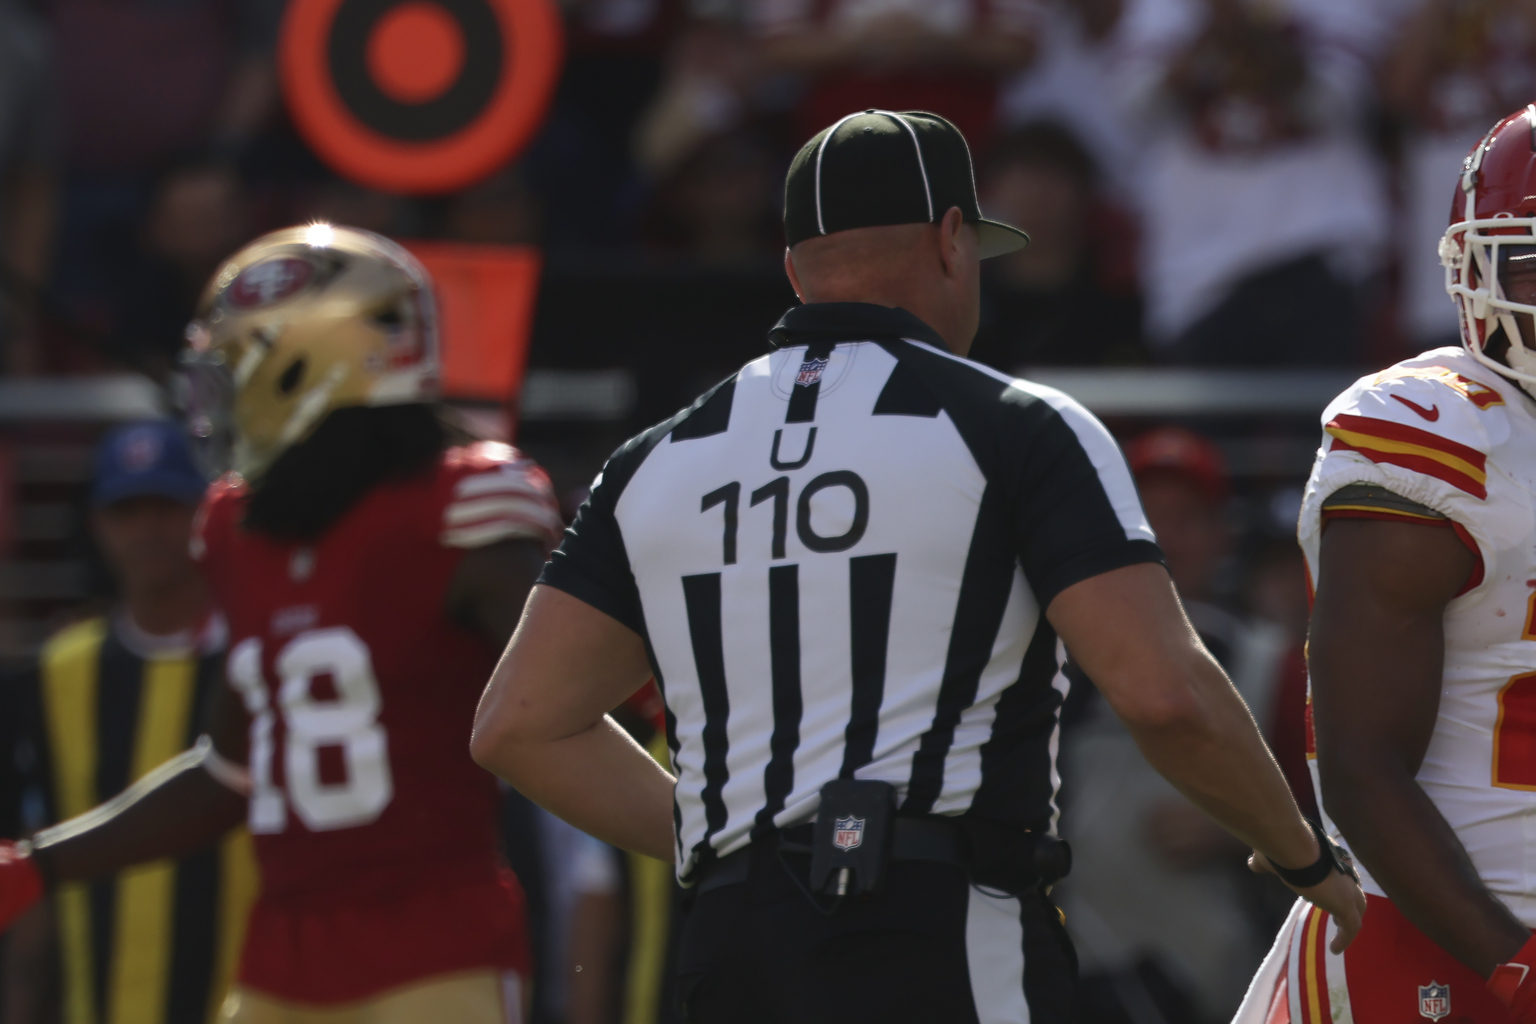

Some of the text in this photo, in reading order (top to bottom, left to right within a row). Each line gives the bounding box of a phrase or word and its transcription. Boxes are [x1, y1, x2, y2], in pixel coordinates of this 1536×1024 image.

[769, 426, 819, 472] U
[700, 469, 870, 566] 110
[226, 626, 394, 834] 18
[836, 831, 859, 847] NFL
[1424, 999, 1446, 1013] NFL
